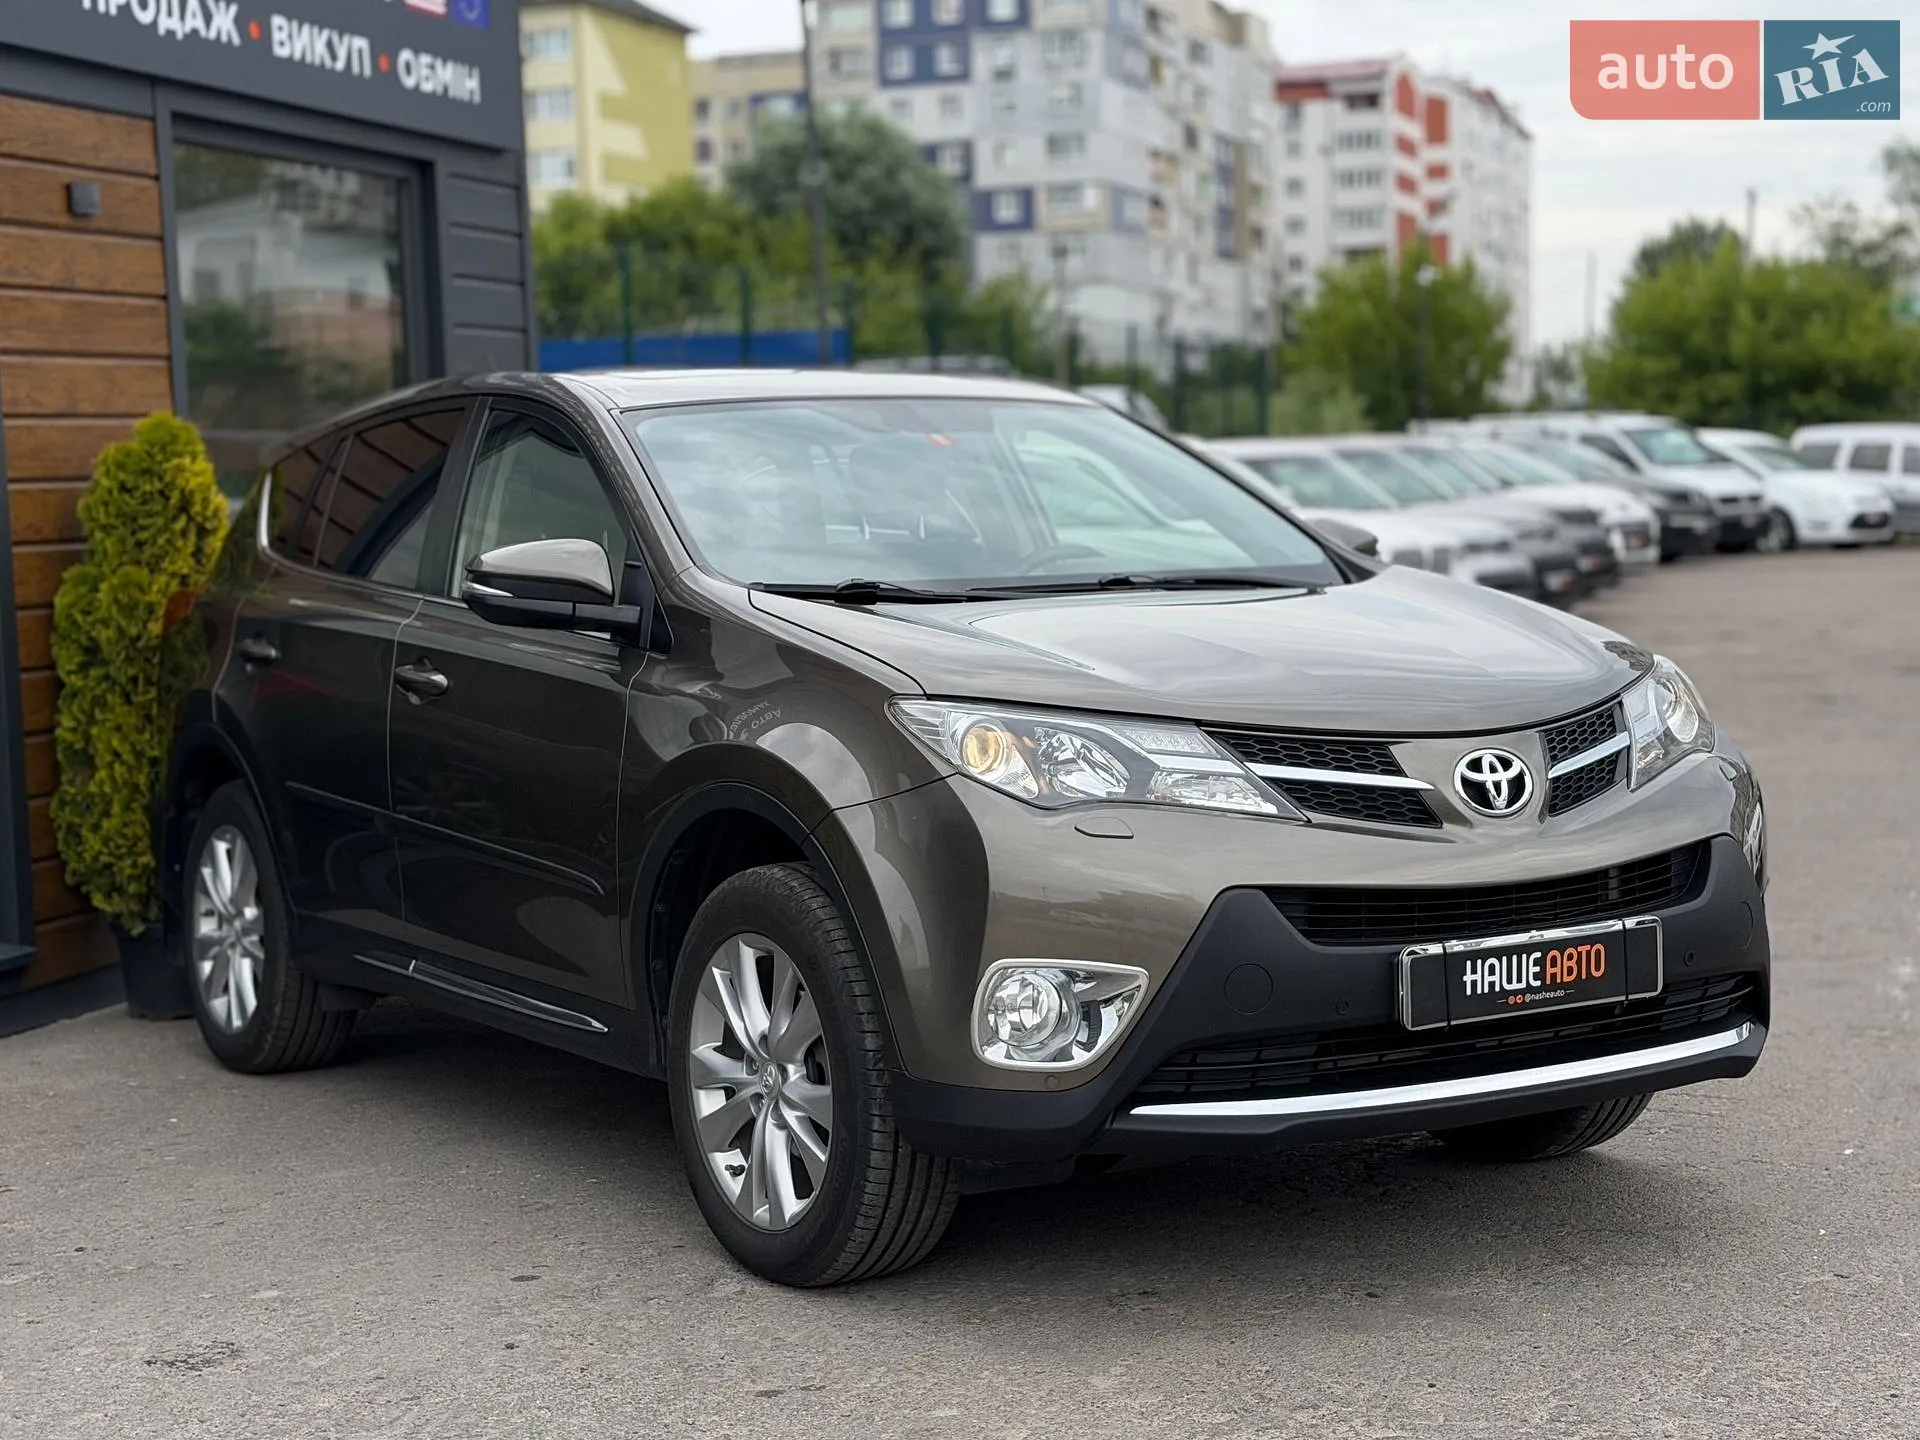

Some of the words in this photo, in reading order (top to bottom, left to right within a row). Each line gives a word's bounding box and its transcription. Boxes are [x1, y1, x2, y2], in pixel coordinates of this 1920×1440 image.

[81, 0, 242, 47] ОДАЖ
[269, 13, 373, 79] ВИКУП
[396, 48, 483, 105] ОБМІН
[1462, 951, 1543, 996] НАШЕ
[1544, 943, 1607, 986] АВТО
